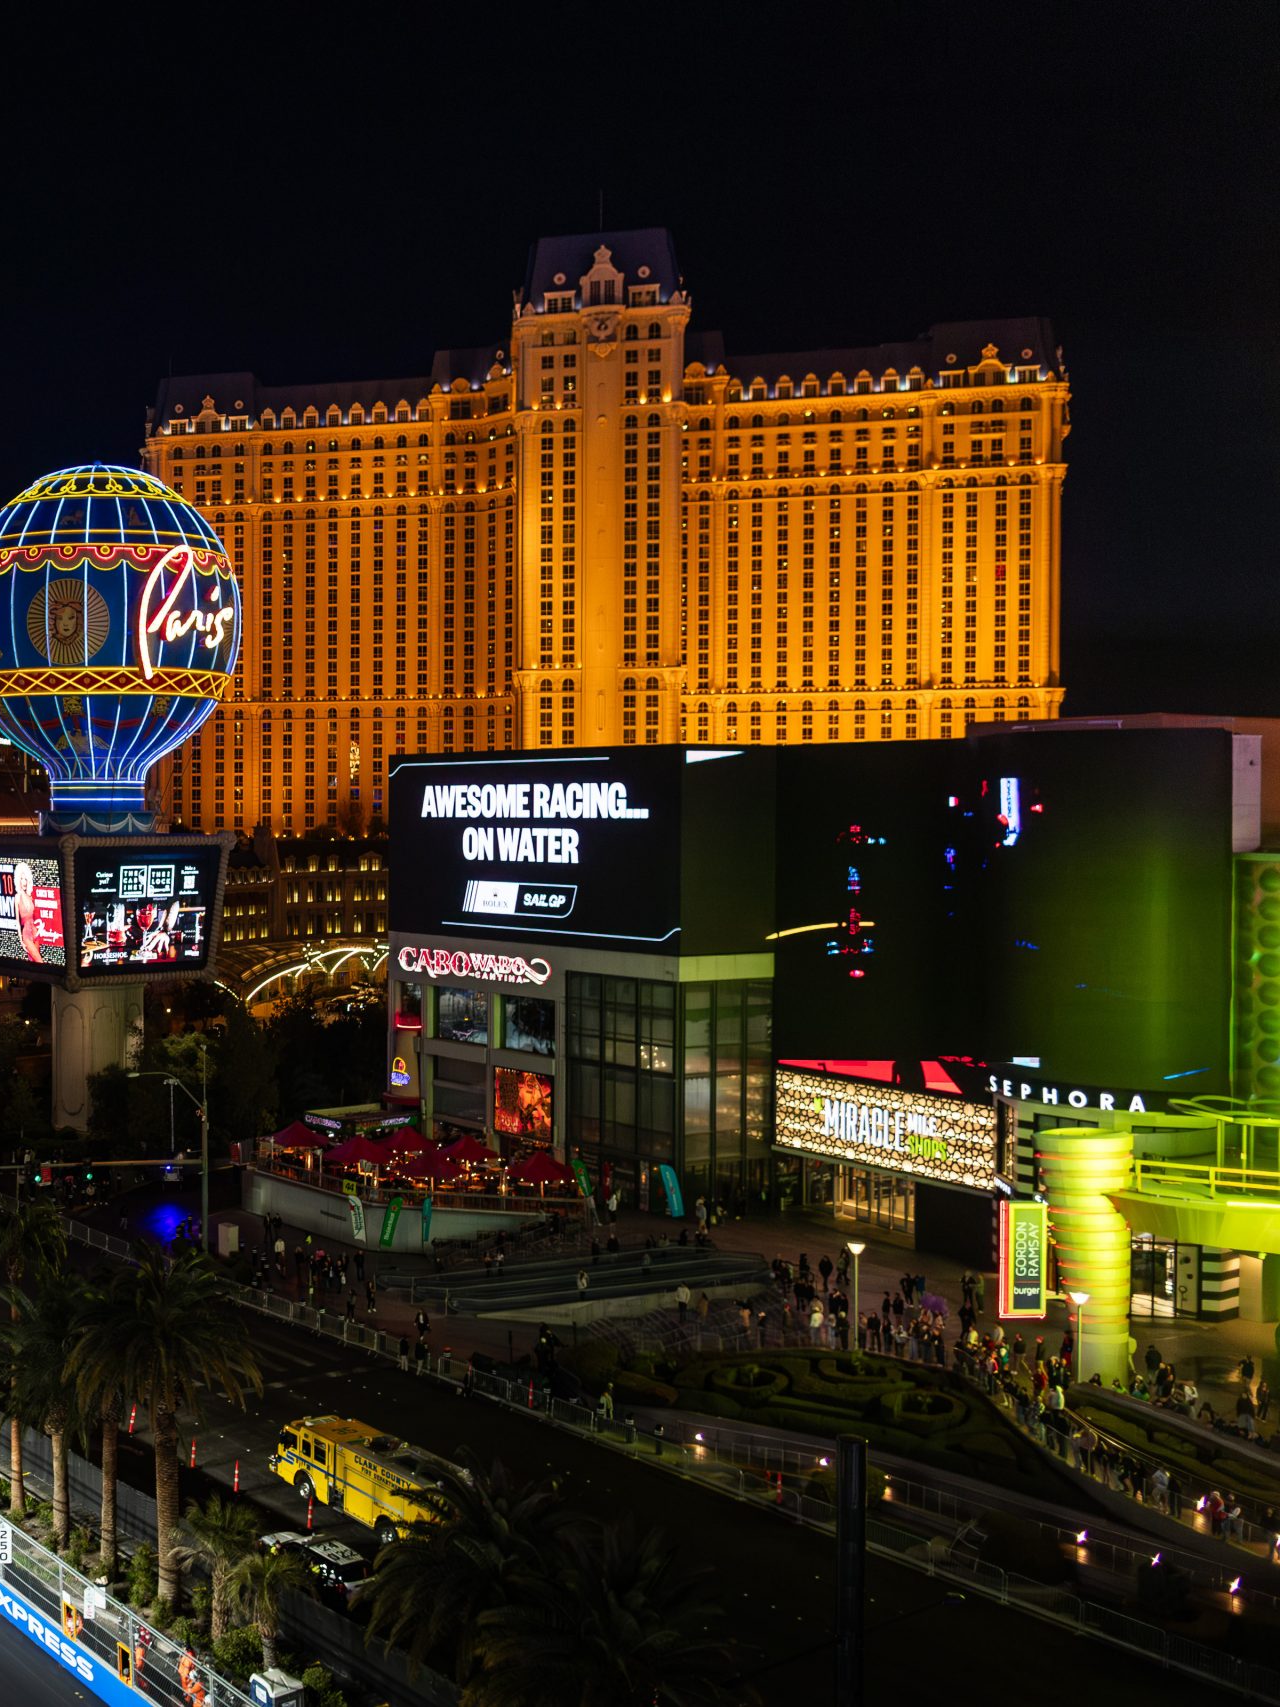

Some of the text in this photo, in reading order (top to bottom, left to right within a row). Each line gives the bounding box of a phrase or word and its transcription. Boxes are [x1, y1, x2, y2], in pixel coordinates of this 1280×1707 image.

[139, 544, 234, 681] Paris
[421, 782, 649, 818] AWESOME RACING...
[462, 827, 579, 863] ON WATER
[2, 874, 13, 895] 10
[483, 900, 508, 908] ROLEX
[398, 946, 528, 978] CABO WABO
[475, 972, 523, 984] CANTINA
[989, 1075, 1146, 1113] SEPHORA
[824, 1097, 937, 1153] MIRACLE MILE
[908, 1135, 947, 1162] SHOPS
[1016, 1222, 1027, 1277] GORDON
[1028, 1222, 1040, 1277] RAMSAY
[1014, 1286, 1040, 1297] burger
[354, 1454, 412, 1490] CLARK COUNTY
[0, 1530, 8, 1561] 250
